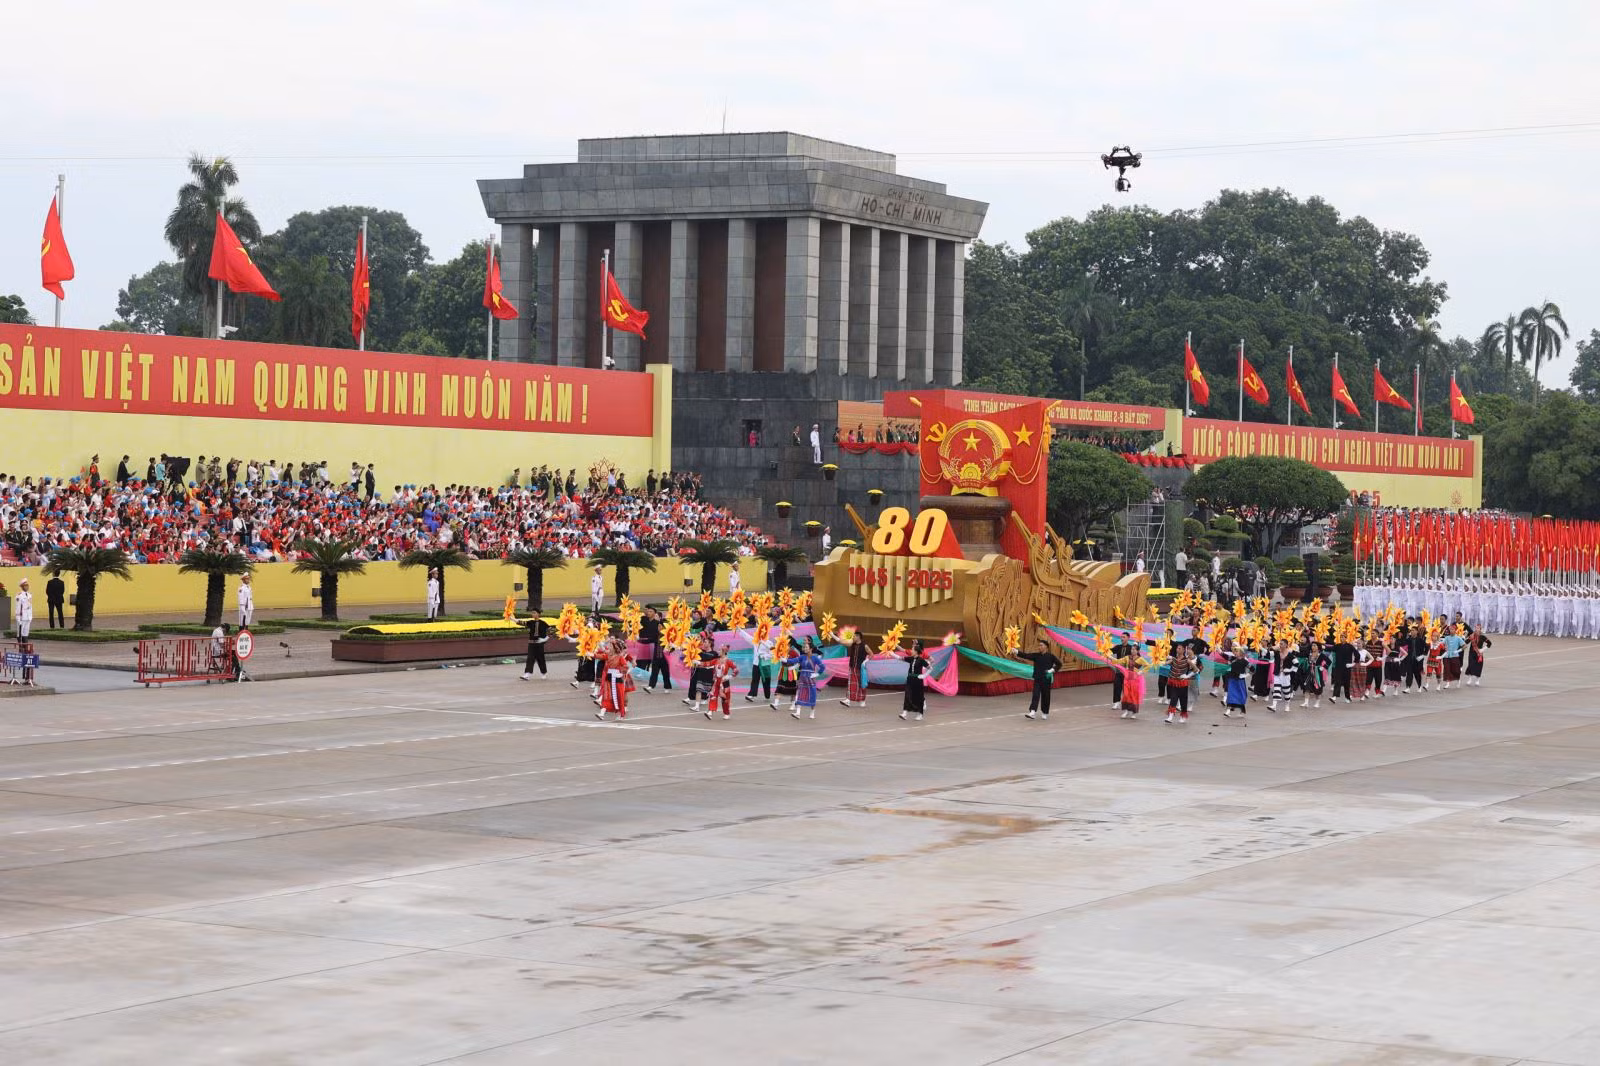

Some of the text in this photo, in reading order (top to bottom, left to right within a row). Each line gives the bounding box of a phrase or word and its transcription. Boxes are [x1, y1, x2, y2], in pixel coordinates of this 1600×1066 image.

[0, 333, 61, 397] SẢN
[81, 343, 154, 410] VIỆT
[172, 355, 235, 406] NAM
[254, 360, 348, 413] QUANG
[364, 368, 426, 416] VINH
[441, 370, 511, 420] MUÔN
[964, 399, 980, 412] TINH
[1192, 424, 1222, 457] NƯỚC
[1375, 437, 1394, 472] VIỆT
[1396, 443, 1414, 468] NAM
[872, 507, 948, 555] 80
[848, 567, 888, 587] 1945
[907, 569, 953, 590] 2025
